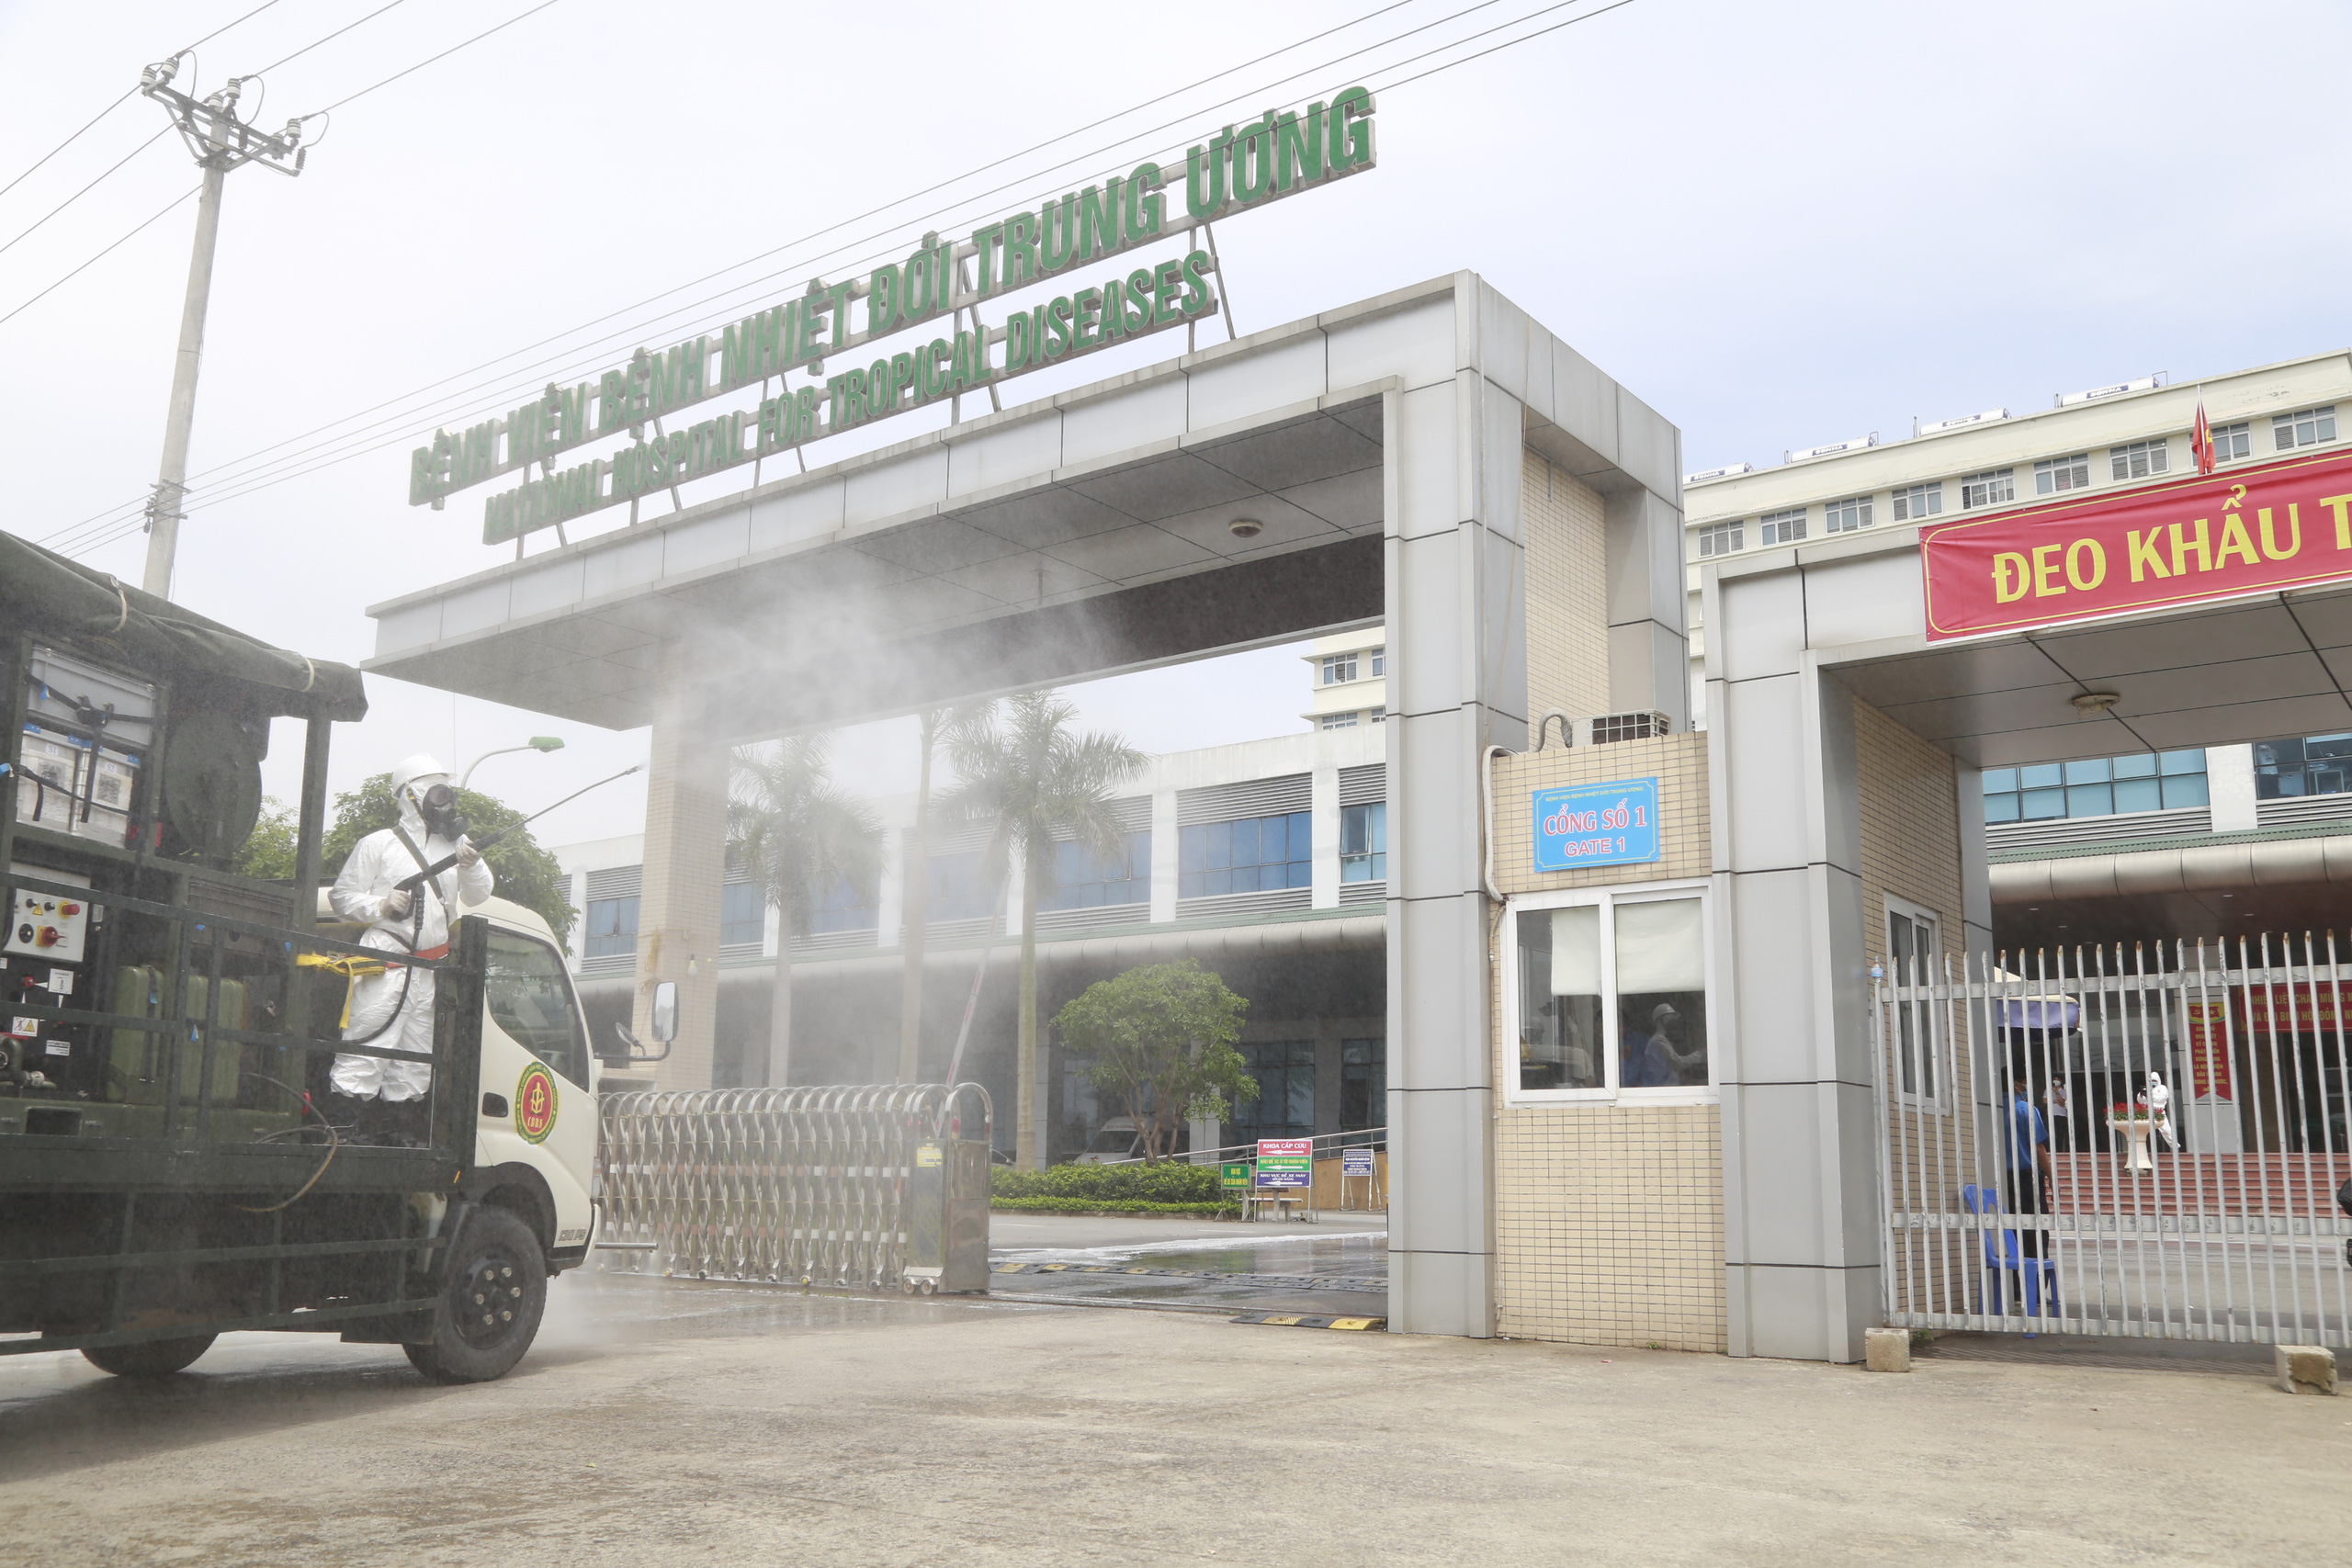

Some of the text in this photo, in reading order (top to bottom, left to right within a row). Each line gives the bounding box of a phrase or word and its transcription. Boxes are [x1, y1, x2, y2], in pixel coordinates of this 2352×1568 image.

[598, 347, 712, 439] BỆNH
[719, 278, 860, 376] NHIỆT
[972, 162, 1167, 297] TRUNG
[1186, 85, 1376, 220] ƯƠNG
[482, 249, 1217, 546] NATIONAL HOSPITAL FOR TROPICAL DISEASES
[1991, 537, 2107, 604] ĐEO
[2126, 483, 2301, 583] KHẨU
[1544, 798, 1647, 836] CỔNG SỐ 1
[1565, 837, 1625, 857] GATE 1
[1281, 1141, 1294, 1149] CẤP
[1294, 1141, 1307, 1149] CỨU
